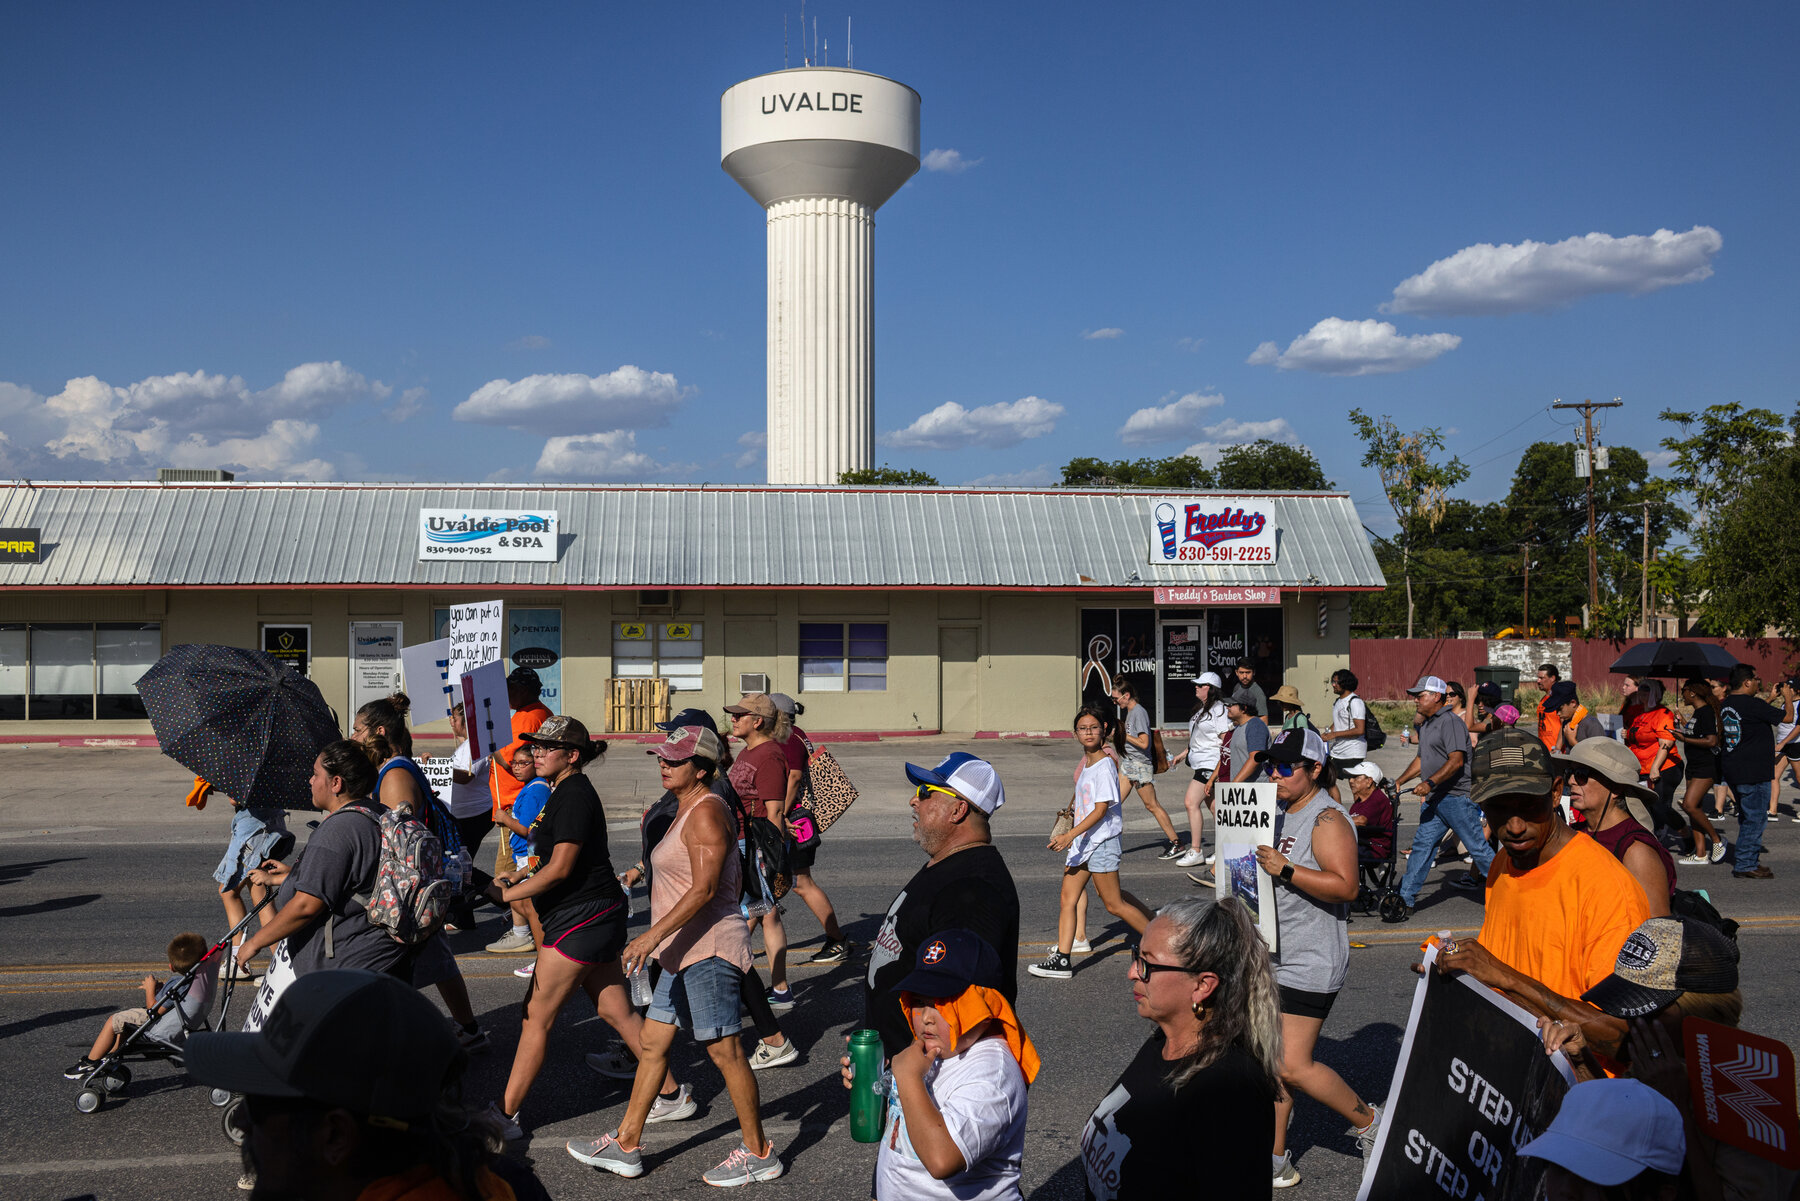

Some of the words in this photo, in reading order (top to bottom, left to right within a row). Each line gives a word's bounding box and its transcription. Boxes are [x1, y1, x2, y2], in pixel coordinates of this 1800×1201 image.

[762, 92, 863, 115] UVALDE
[429, 516, 500, 532] Uvalde
[504, 518, 550, 533] Pool
[1184, 503, 1266, 538] Freddy's
[426, 545, 492, 554] 830-900-7052
[498, 536, 509, 548] &
[512, 537, 543, 548] SPA
[1179, 546, 1271, 561] 830-591-2225
[1168, 588, 1208, 602] Freddy's
[1209, 588, 1242, 602] Barber
[1244, 589, 1266, 602] Shop
[450, 607, 464, 629] you
[465, 606, 478, 621] can
[480, 604, 491, 624] put
[493, 605, 500, 618] a
[480, 631, 489, 642] on
[491, 631, 498, 642] a
[521, 625, 560, 633] PENTAIR
[1212, 633, 1243, 650] Uvalde
[466, 644, 480, 660] but
[482, 645, 498, 662] NOT
[1121, 657, 1156, 675] STRONG
[421, 766, 450, 776] STOLS
[1221, 787, 1258, 806] LAYLA
[1216, 809, 1270, 828] SALAZAR
[1621, 1001, 1658, 1017] TEXAS
[1696, 1033, 1719, 1124] WHATABURGER
[1447, 1057, 1514, 1126] STEP
[1404, 1129, 1469, 1199] STEP
[1468, 1130, 1503, 1187] OR
